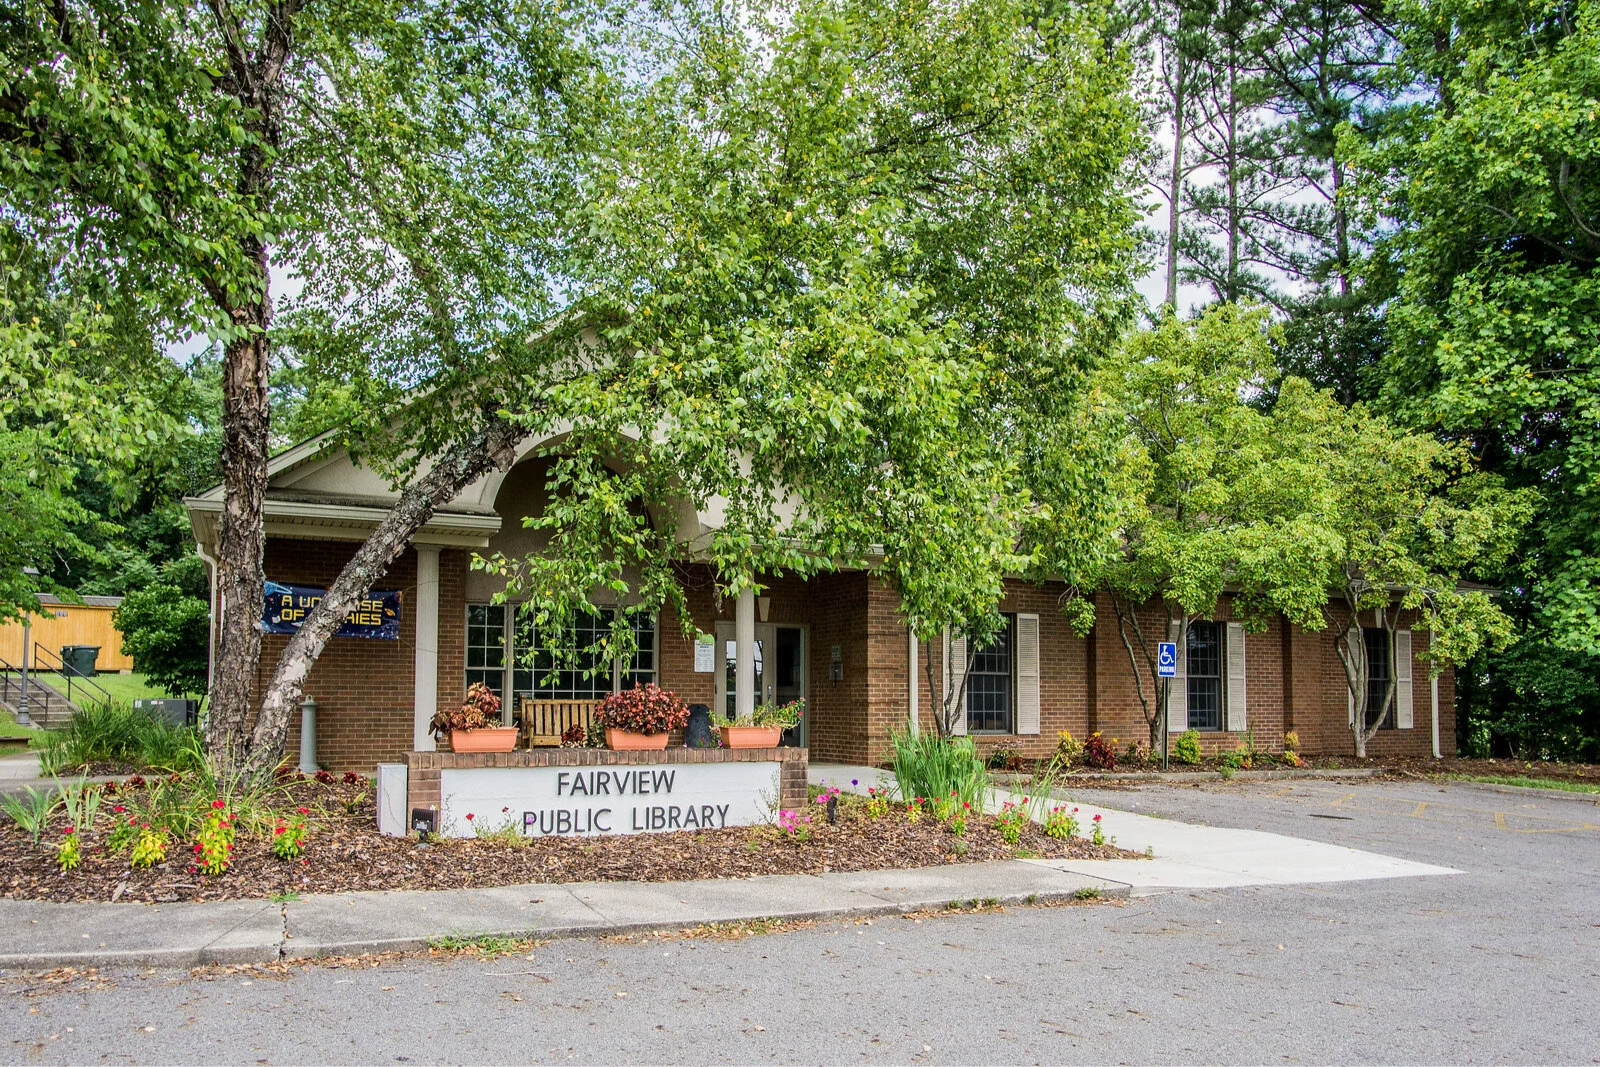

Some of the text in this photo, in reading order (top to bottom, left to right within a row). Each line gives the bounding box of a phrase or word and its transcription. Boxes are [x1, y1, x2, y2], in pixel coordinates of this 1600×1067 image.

[281, 595, 383, 612] A UNSE
[281, 609, 305, 621] OF
[557, 770, 676, 796] FAIRVIEW
[523, 804, 730, 835] PUBLIC LIBRARY
